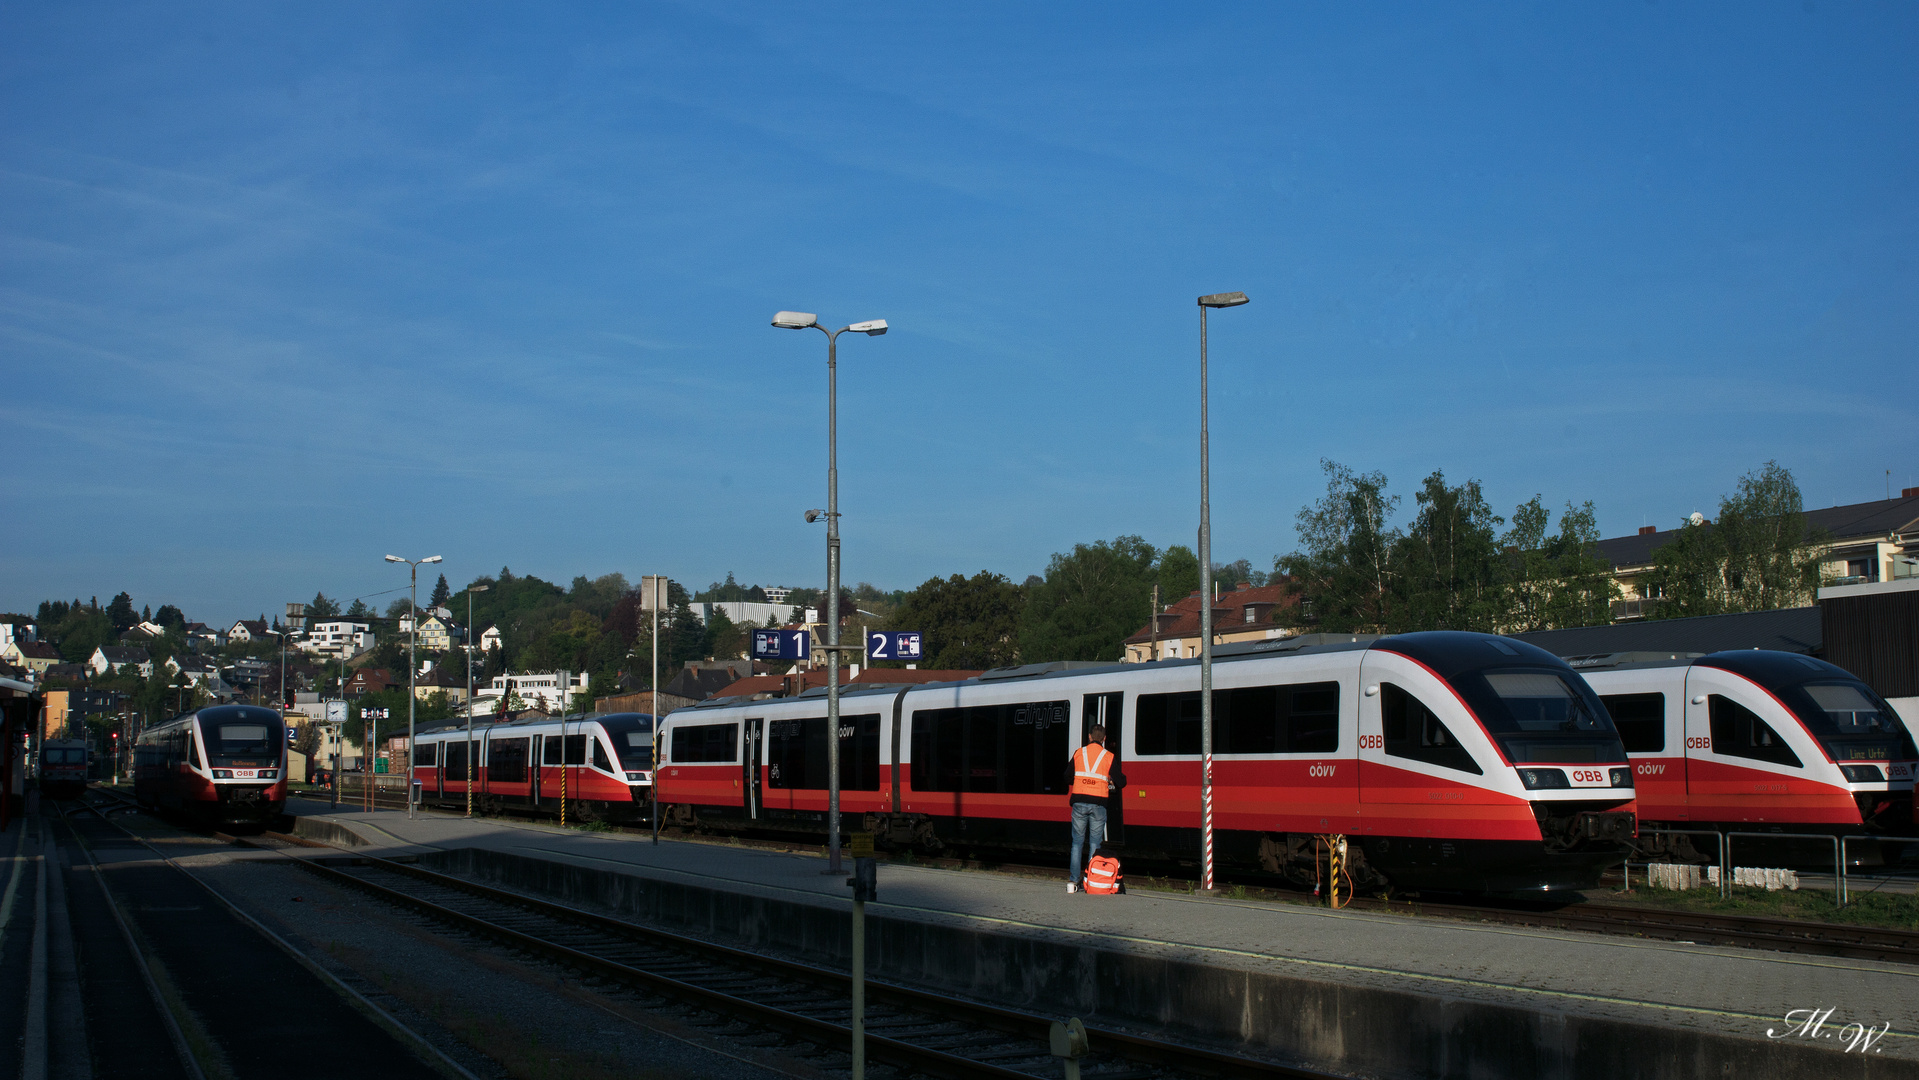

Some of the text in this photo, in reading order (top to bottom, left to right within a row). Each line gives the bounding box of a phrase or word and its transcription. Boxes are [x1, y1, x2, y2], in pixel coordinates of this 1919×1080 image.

[792, 632, 804, 657] 1
[871, 633, 888, 658] 2
[1014, 700, 1070, 730] cityjet
[288, 729, 295, 738] 2
[1359, 735, 1383, 749] ÖBB
[1686, 737, 1711, 749] ÖBB
[1850, 748, 1866, 759] Linz
[1309, 762, 1336, 777] OÖVV
[1637, 762, 1666, 775] OÖVV
[1885, 766, 1908, 776] ÖBB
[1572, 770, 1603, 782] ÖBB
